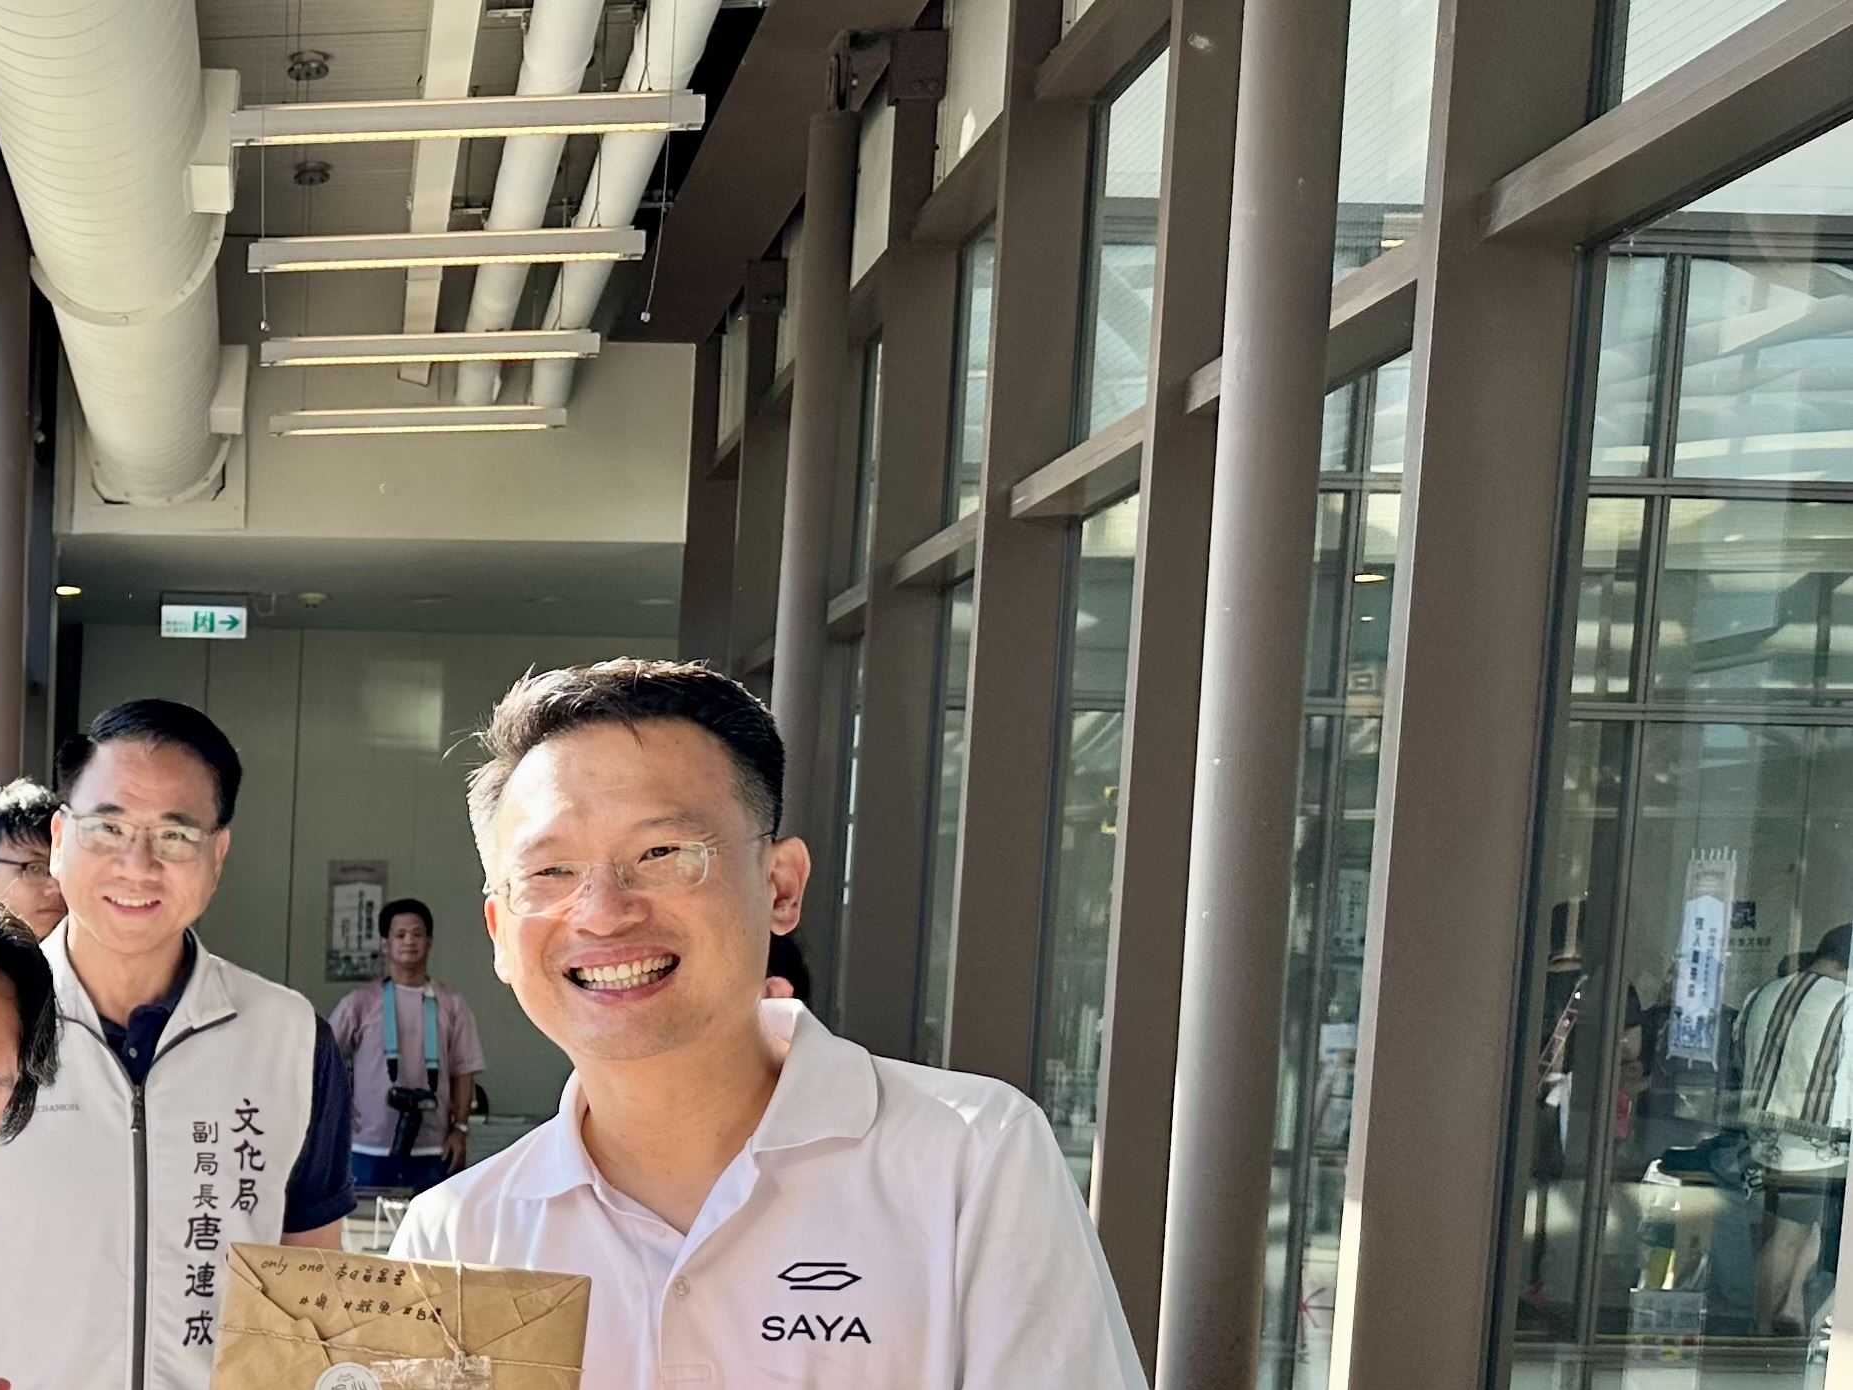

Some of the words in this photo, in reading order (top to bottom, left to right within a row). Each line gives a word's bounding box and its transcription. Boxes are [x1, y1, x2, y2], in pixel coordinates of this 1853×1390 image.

[231, 1098, 265, 1216] 文化局
[182, 1121, 222, 1346] 副局長唐連成
[261, 1256, 288, 1275] only
[298, 1263, 324, 1272] one
[761, 1314, 871, 1344] SAYA
